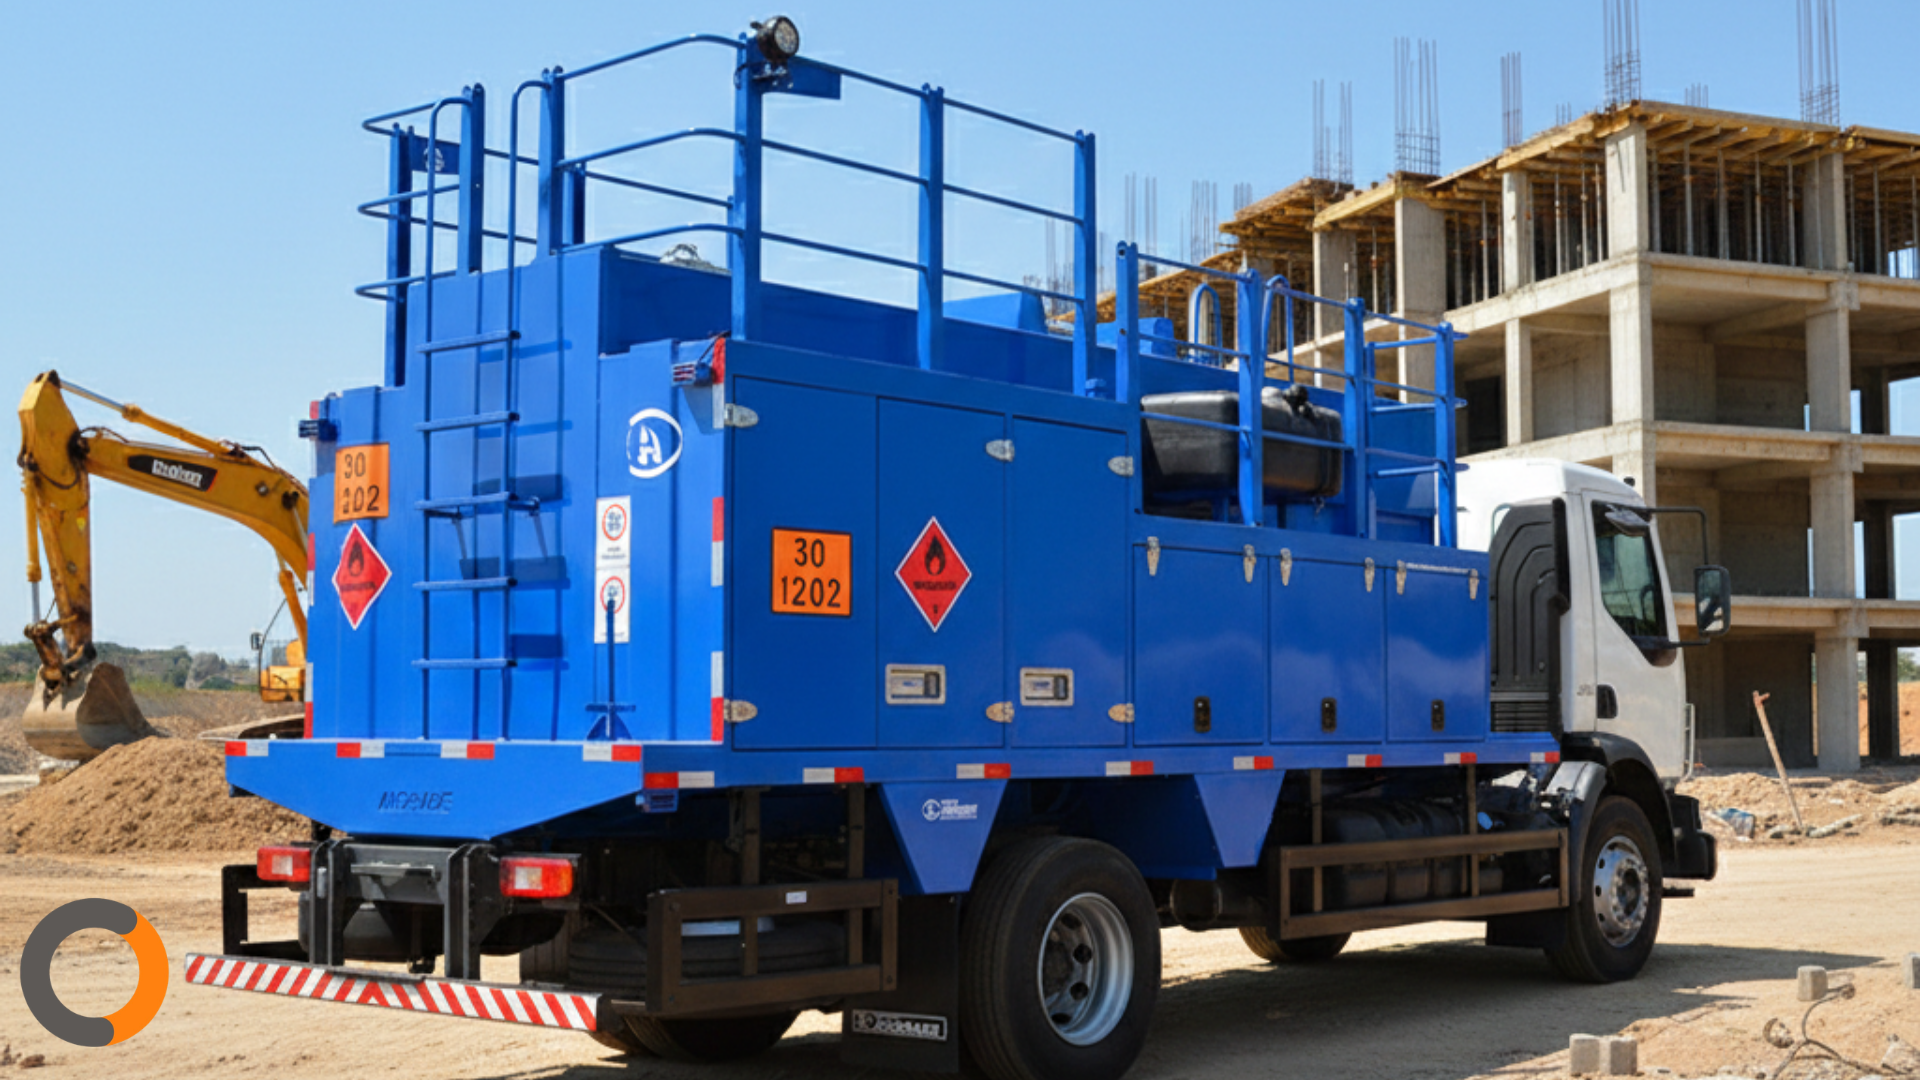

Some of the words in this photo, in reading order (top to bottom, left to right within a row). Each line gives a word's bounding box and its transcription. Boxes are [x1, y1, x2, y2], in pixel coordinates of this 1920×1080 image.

[344, 451, 367, 479] 30
[794, 537, 825, 568] 30
[781, 575, 841, 608] 1202
